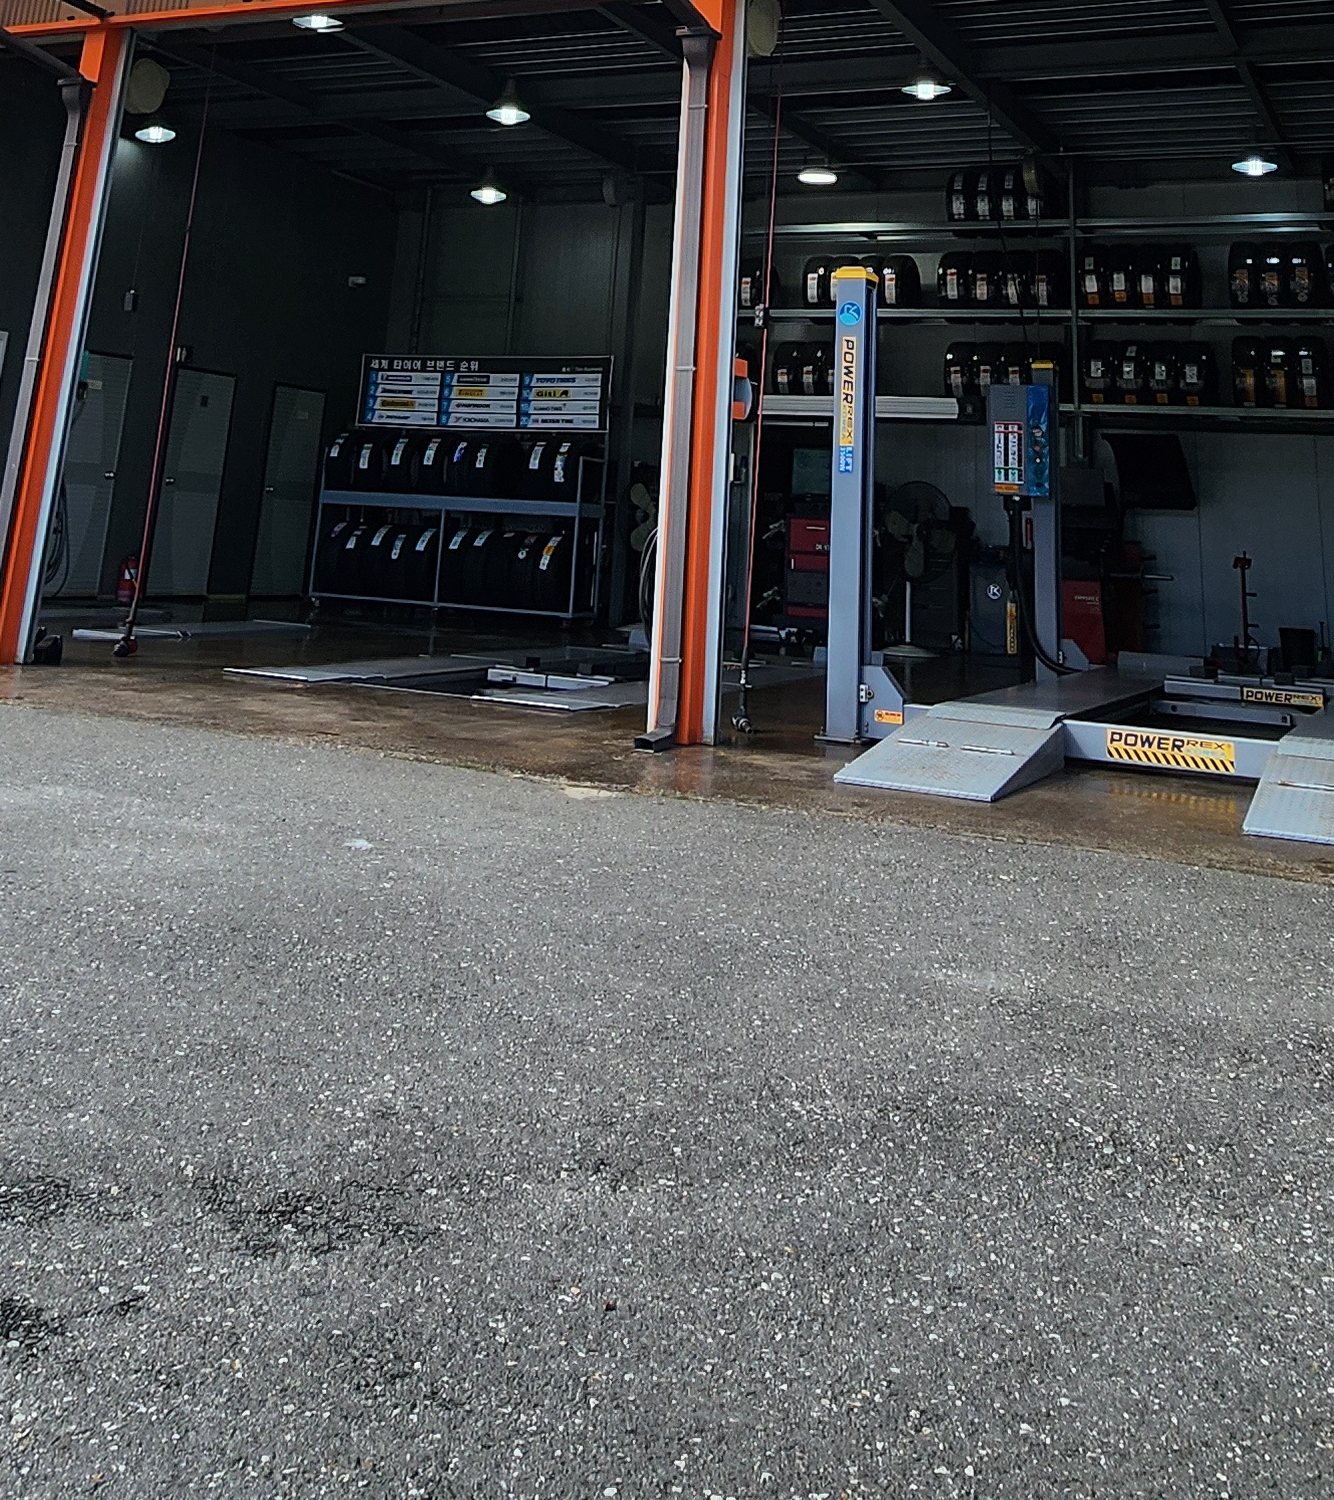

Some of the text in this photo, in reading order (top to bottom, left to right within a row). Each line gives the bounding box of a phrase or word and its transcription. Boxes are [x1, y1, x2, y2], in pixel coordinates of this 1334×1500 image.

[393, 360, 421, 370] 타이어
[426, 360, 455, 370] 브랜드
[460, 361, 479, 371] 순위
[842, 338, 855, 402] POWER
[1245, 689, 1293, 704] POWER
[1109, 731, 1185, 753] POWER
